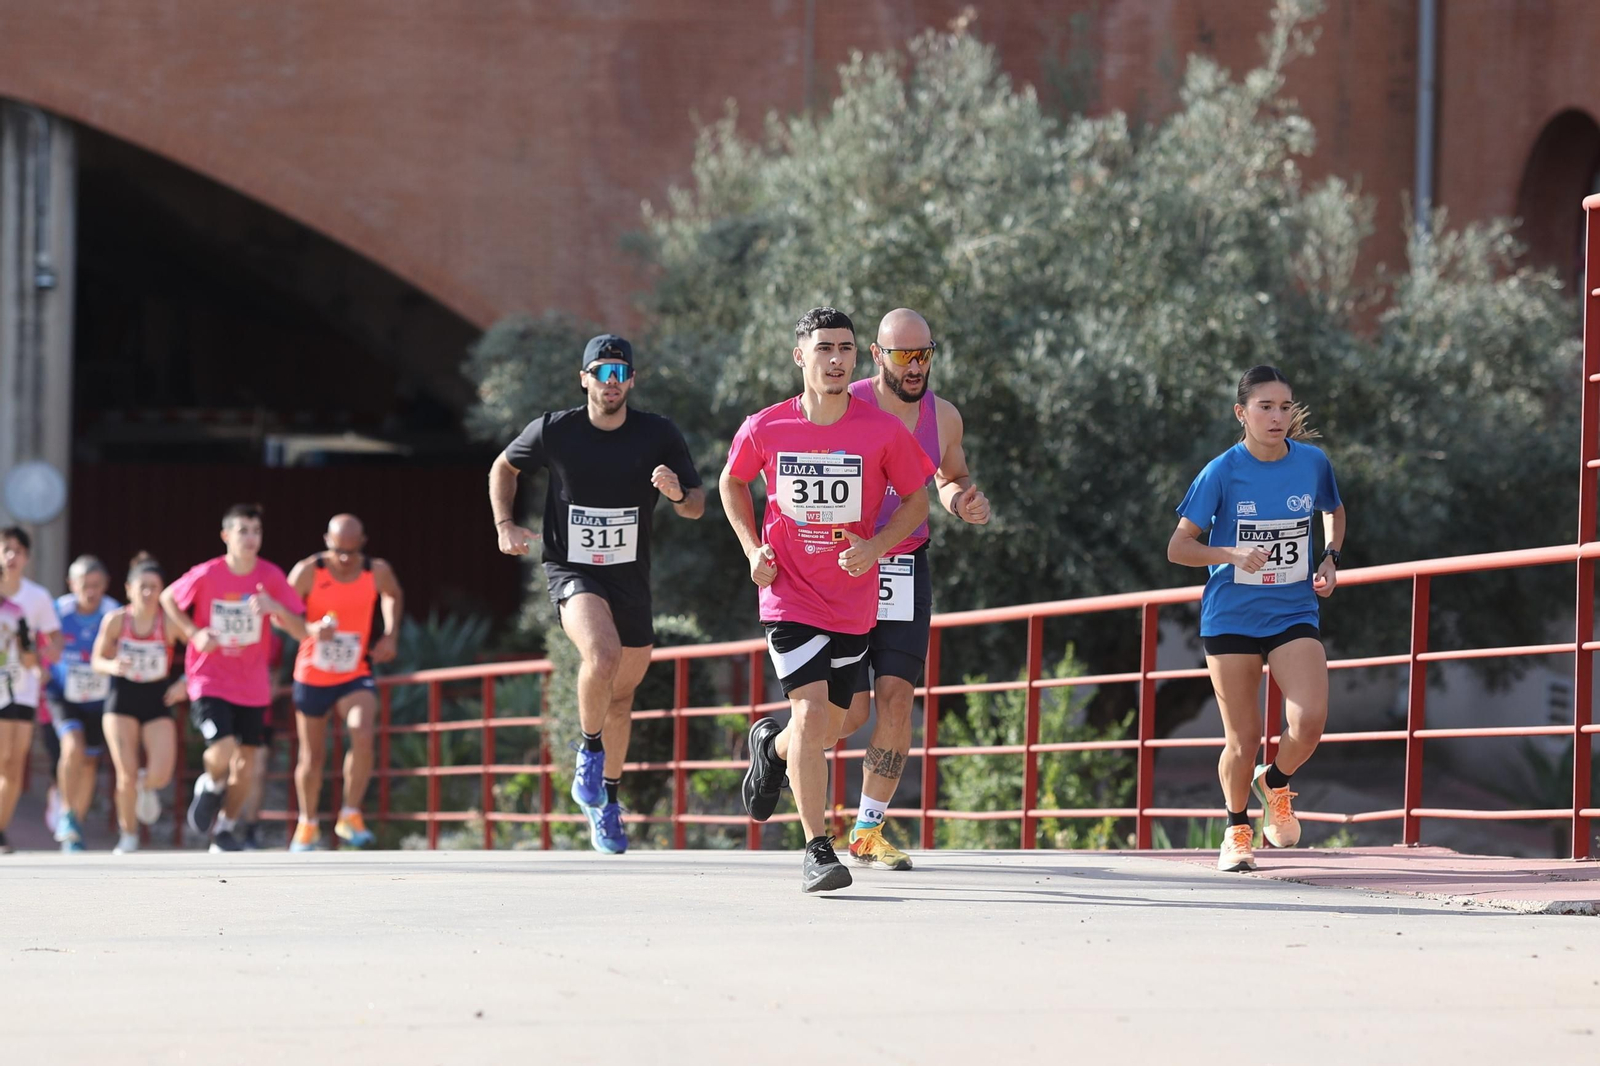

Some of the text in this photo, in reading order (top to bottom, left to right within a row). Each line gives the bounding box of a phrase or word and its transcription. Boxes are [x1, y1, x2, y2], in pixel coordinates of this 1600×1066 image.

[781, 464, 818, 475] UMA
[791, 479, 849, 504] 310
[573, 515, 603, 526] UMA
[581, 528, 627, 549] 311
[1241, 531, 1274, 541] UMA
[1257, 541, 1299, 566] 43
[223, 617, 254, 634] 301
